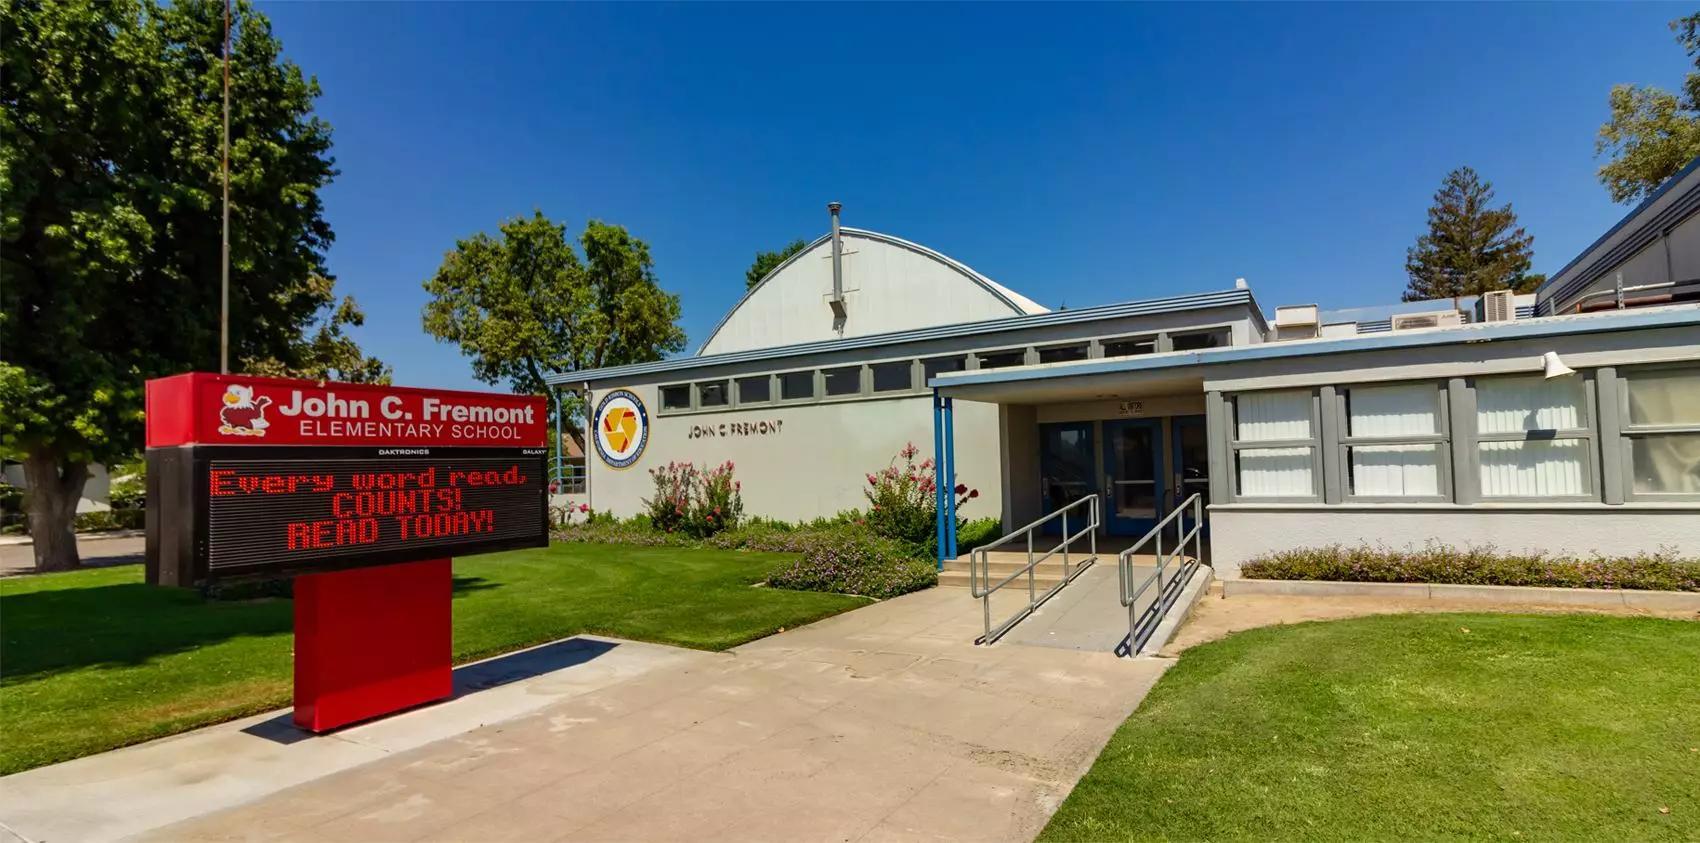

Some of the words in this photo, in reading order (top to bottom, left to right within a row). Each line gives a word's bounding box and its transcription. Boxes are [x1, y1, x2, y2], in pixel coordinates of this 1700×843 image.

[279, 390, 370, 418] John
[380, 395, 413, 420] C.
[423, 398, 534, 424] Fremont
[300, 420, 444, 438] ELEMENTARY
[451, 424, 522, 439] SCHOOL
[688, 425, 715, 439] JOHN
[730, 419, 783, 436] FREMONT
[210, 469, 334, 496] Every
[352, 466, 436, 490] word
[449, 464, 529, 487] read,
[332, 487, 462, 518] COUNTS!
[287, 517, 379, 550] READ
[396, 509, 496, 541] TODAY!
